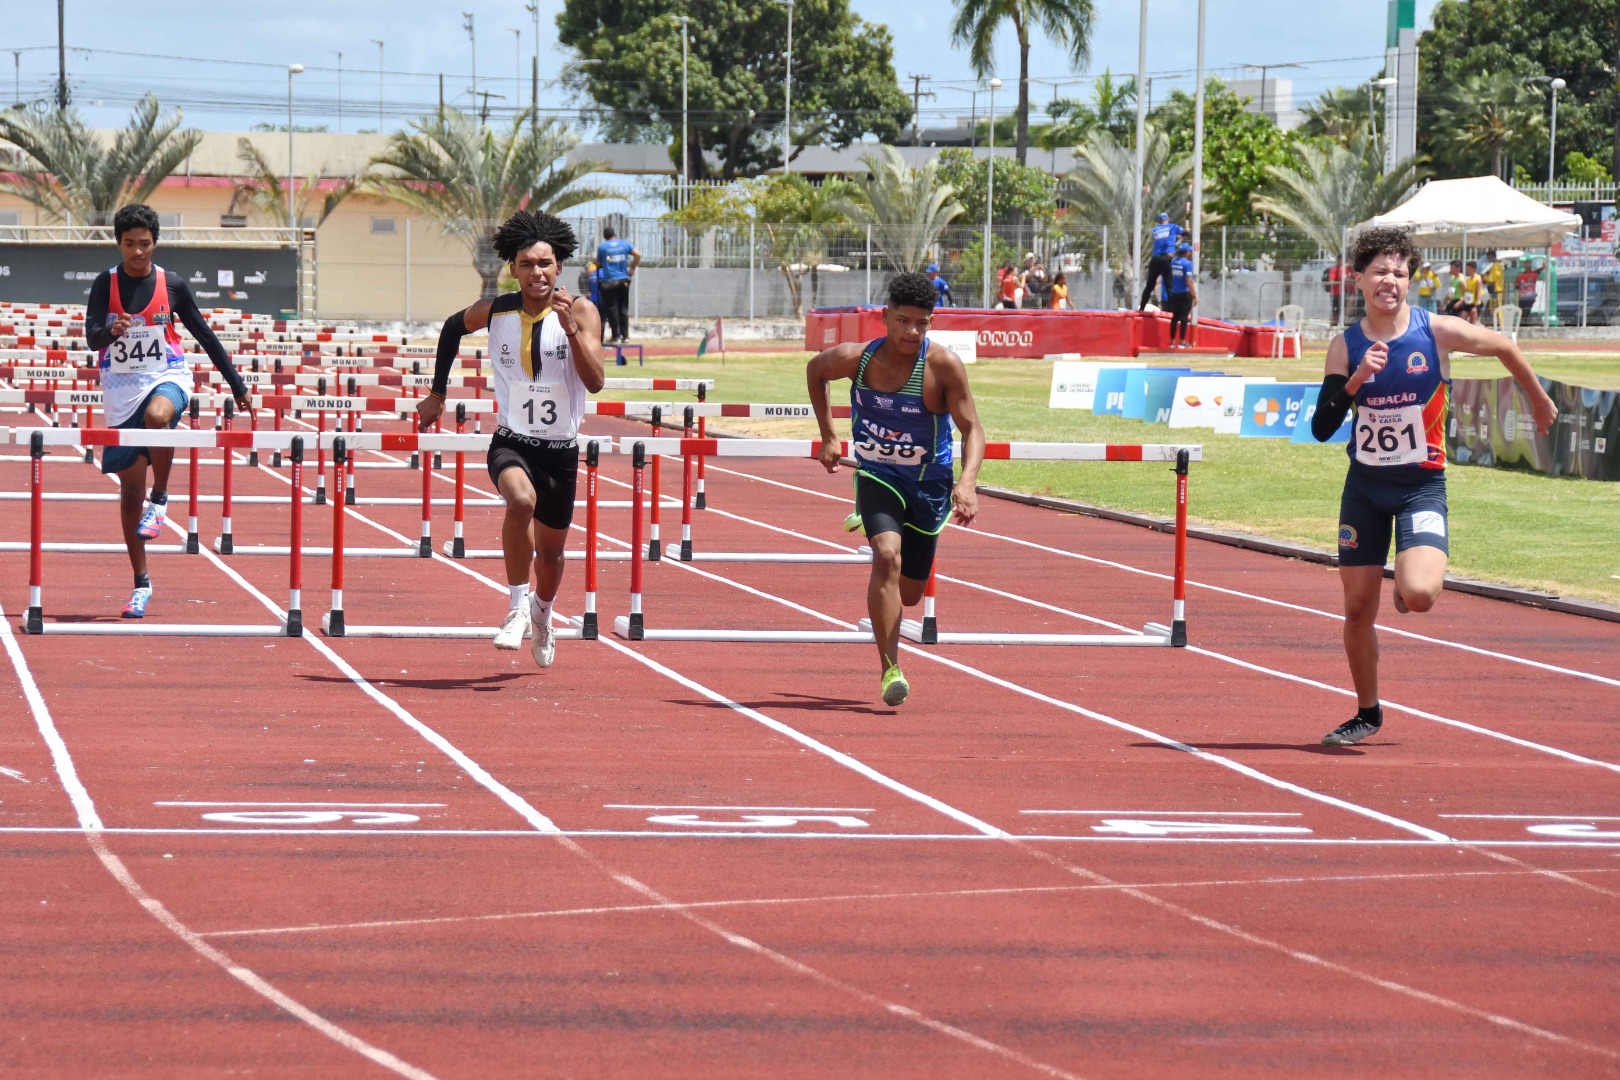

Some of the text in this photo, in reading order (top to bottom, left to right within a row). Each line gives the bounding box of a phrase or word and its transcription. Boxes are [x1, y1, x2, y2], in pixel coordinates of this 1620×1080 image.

[976, 330, 1033, 347] ONDO
[114, 339, 163, 363] 344
[70, 394, 103, 402] MOND
[306, 399, 352, 408] MONDO
[1367, 392, 1417, 406] GERAÇÃO
[522, 399, 557, 425] 13
[765, 407, 809, 416] MONDO
[1284, 413, 1297, 427] C
[548, 439, 577, 449] NIKE
[1359, 424, 1417, 452] 261
[202, 811, 422, 824] 6
[646, 815, 870, 828] 5
[1092, 819, 1314, 835] 4
